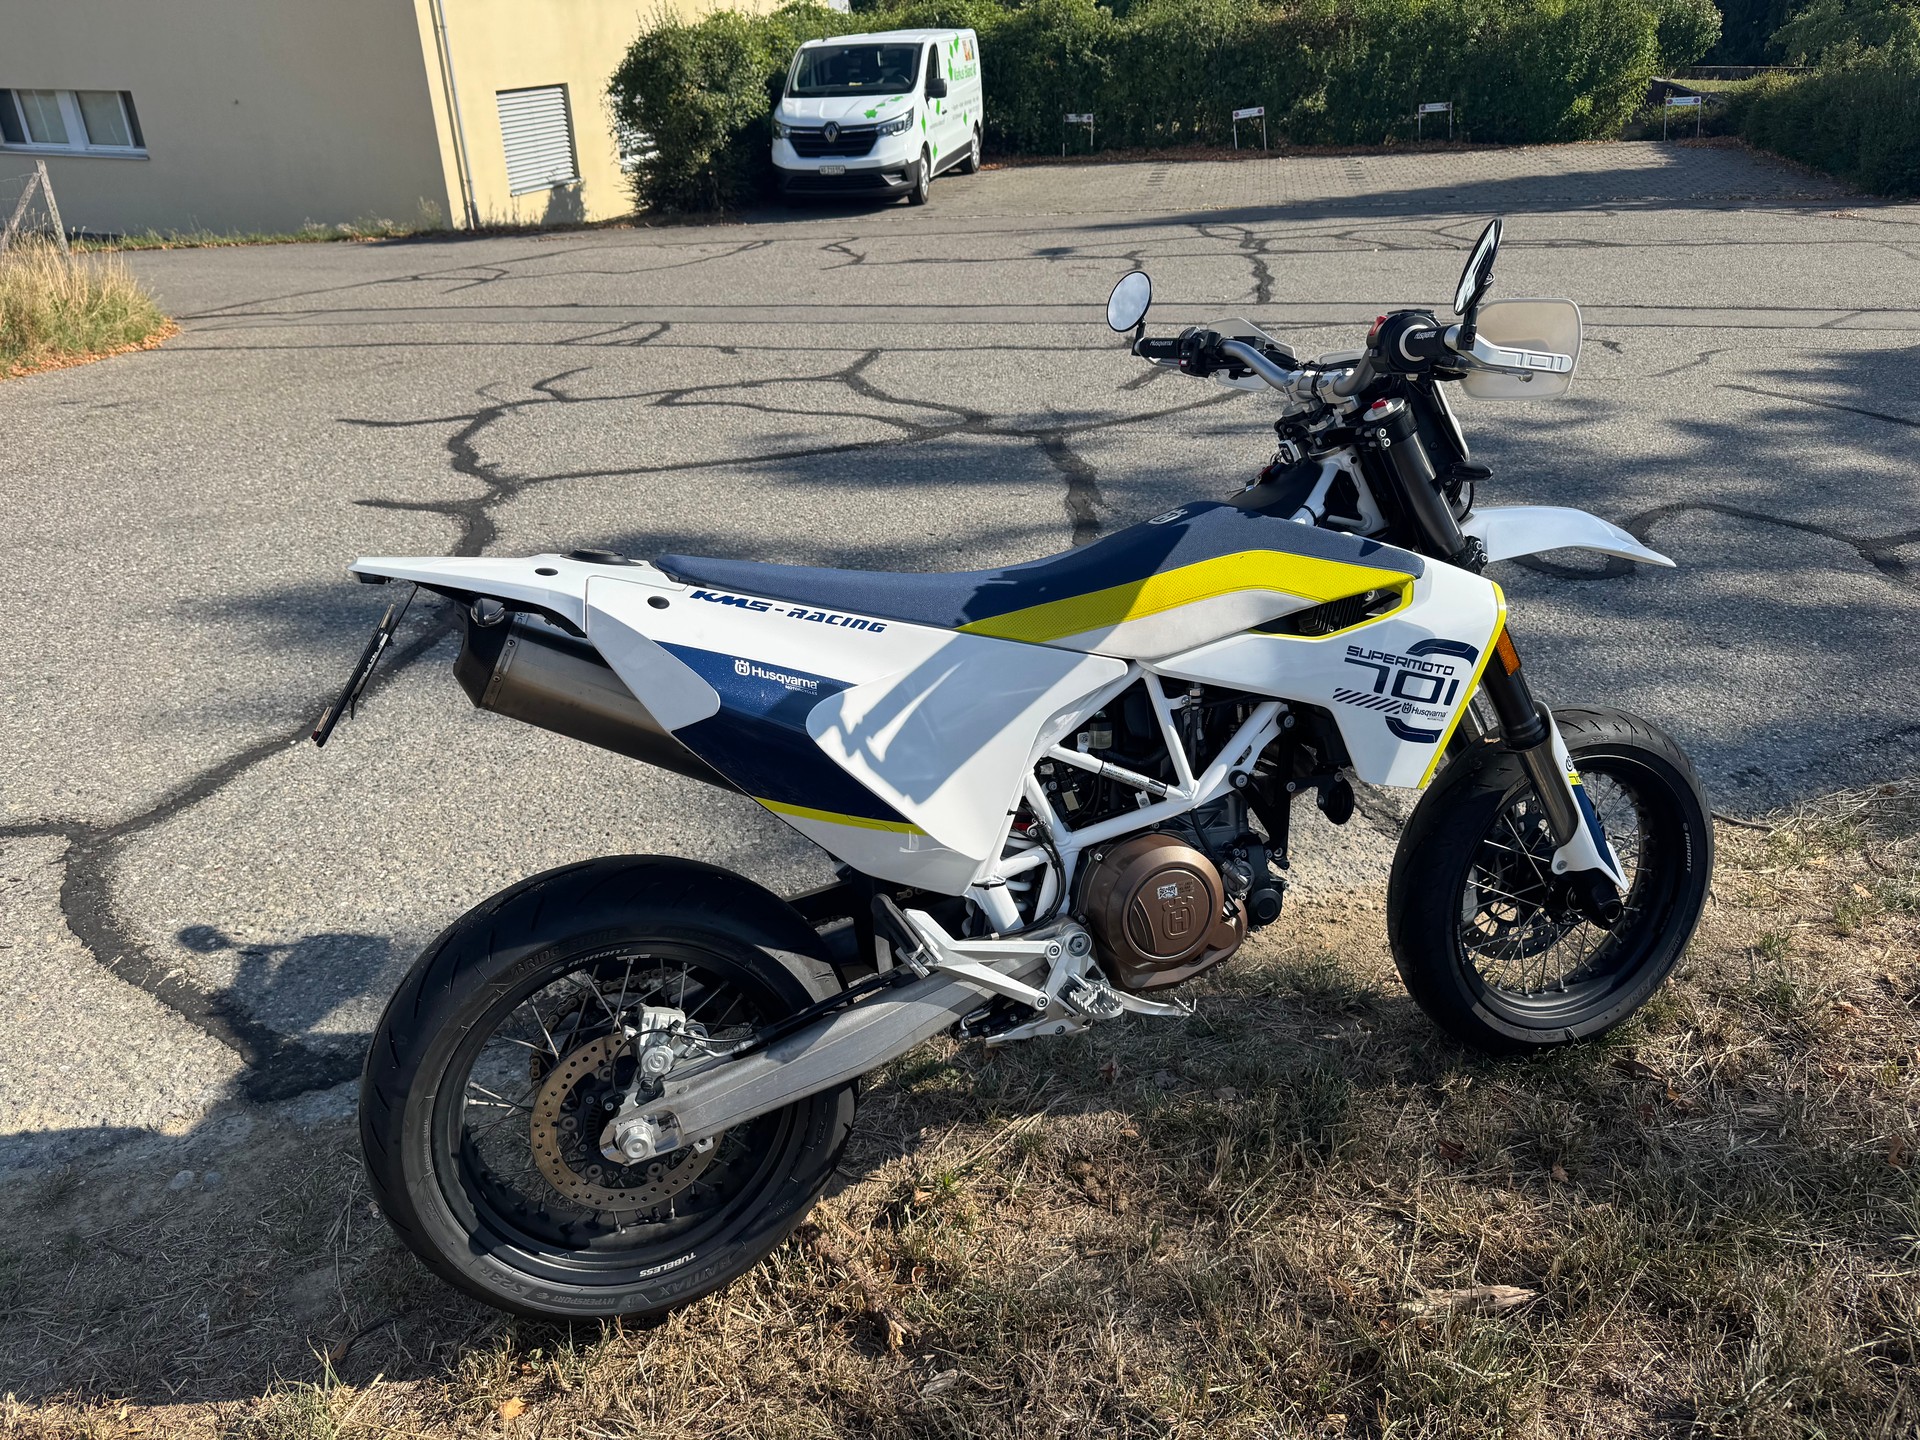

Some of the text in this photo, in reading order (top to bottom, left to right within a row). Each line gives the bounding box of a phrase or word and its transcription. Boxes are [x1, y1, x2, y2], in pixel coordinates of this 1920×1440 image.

[1346, 645, 1455, 676] SUPERMOTO
[751, 666, 818, 689] Husqvarna
[1344, 657, 1460, 706] 701
[1411, 706, 1447, 718] Husqvarna
[639, 1252, 697, 1278] TUBELESS
[551, 1295, 616, 1306] HYPERSPORT
